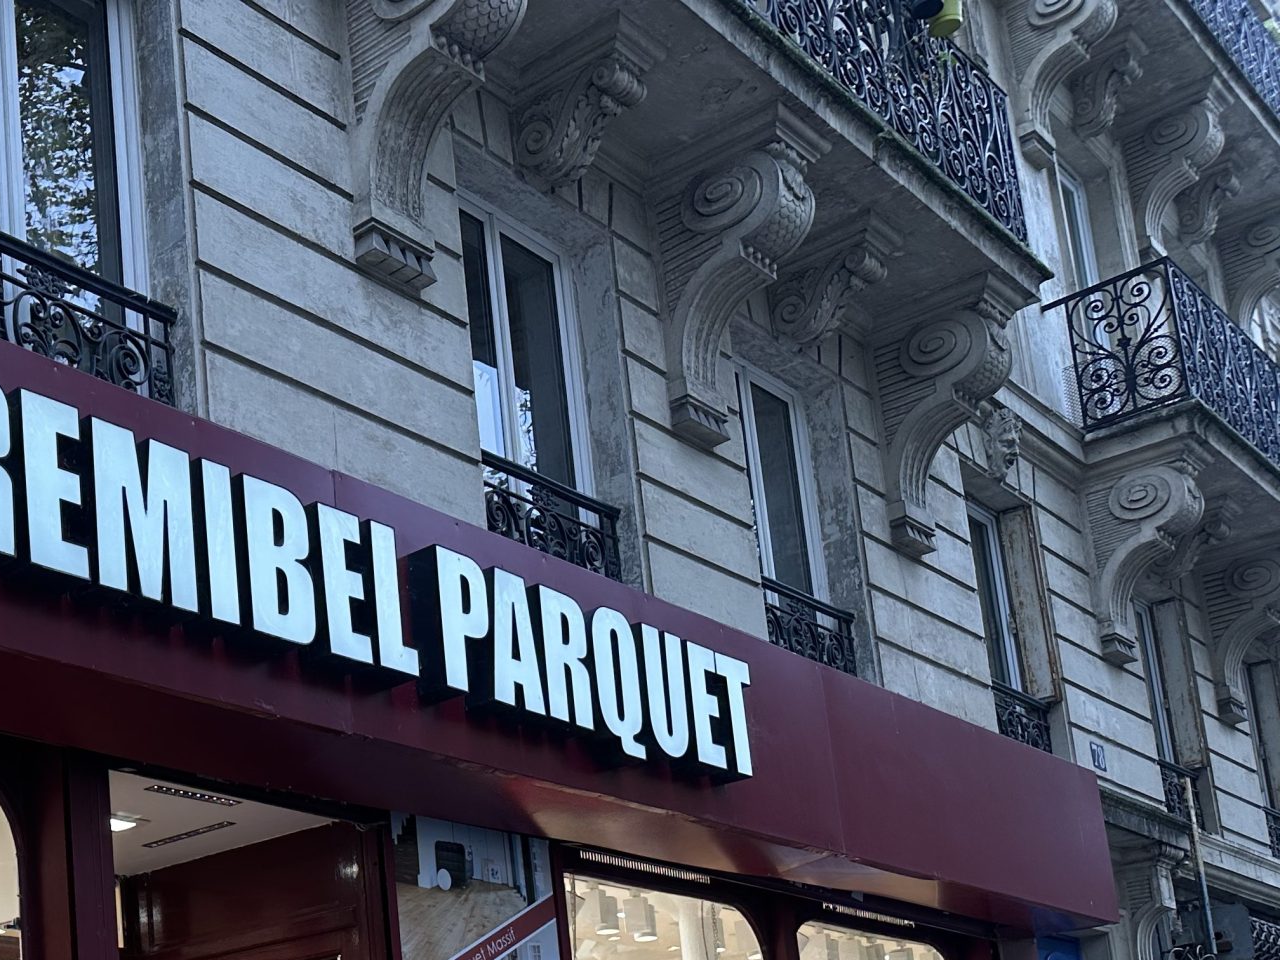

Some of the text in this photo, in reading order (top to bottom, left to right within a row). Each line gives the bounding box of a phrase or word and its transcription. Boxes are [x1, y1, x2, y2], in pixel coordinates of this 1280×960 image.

[435, 544, 754, 777] PARQUET
[1091, 743, 1105, 769] 78
[487, 927, 517, 959] Massif
